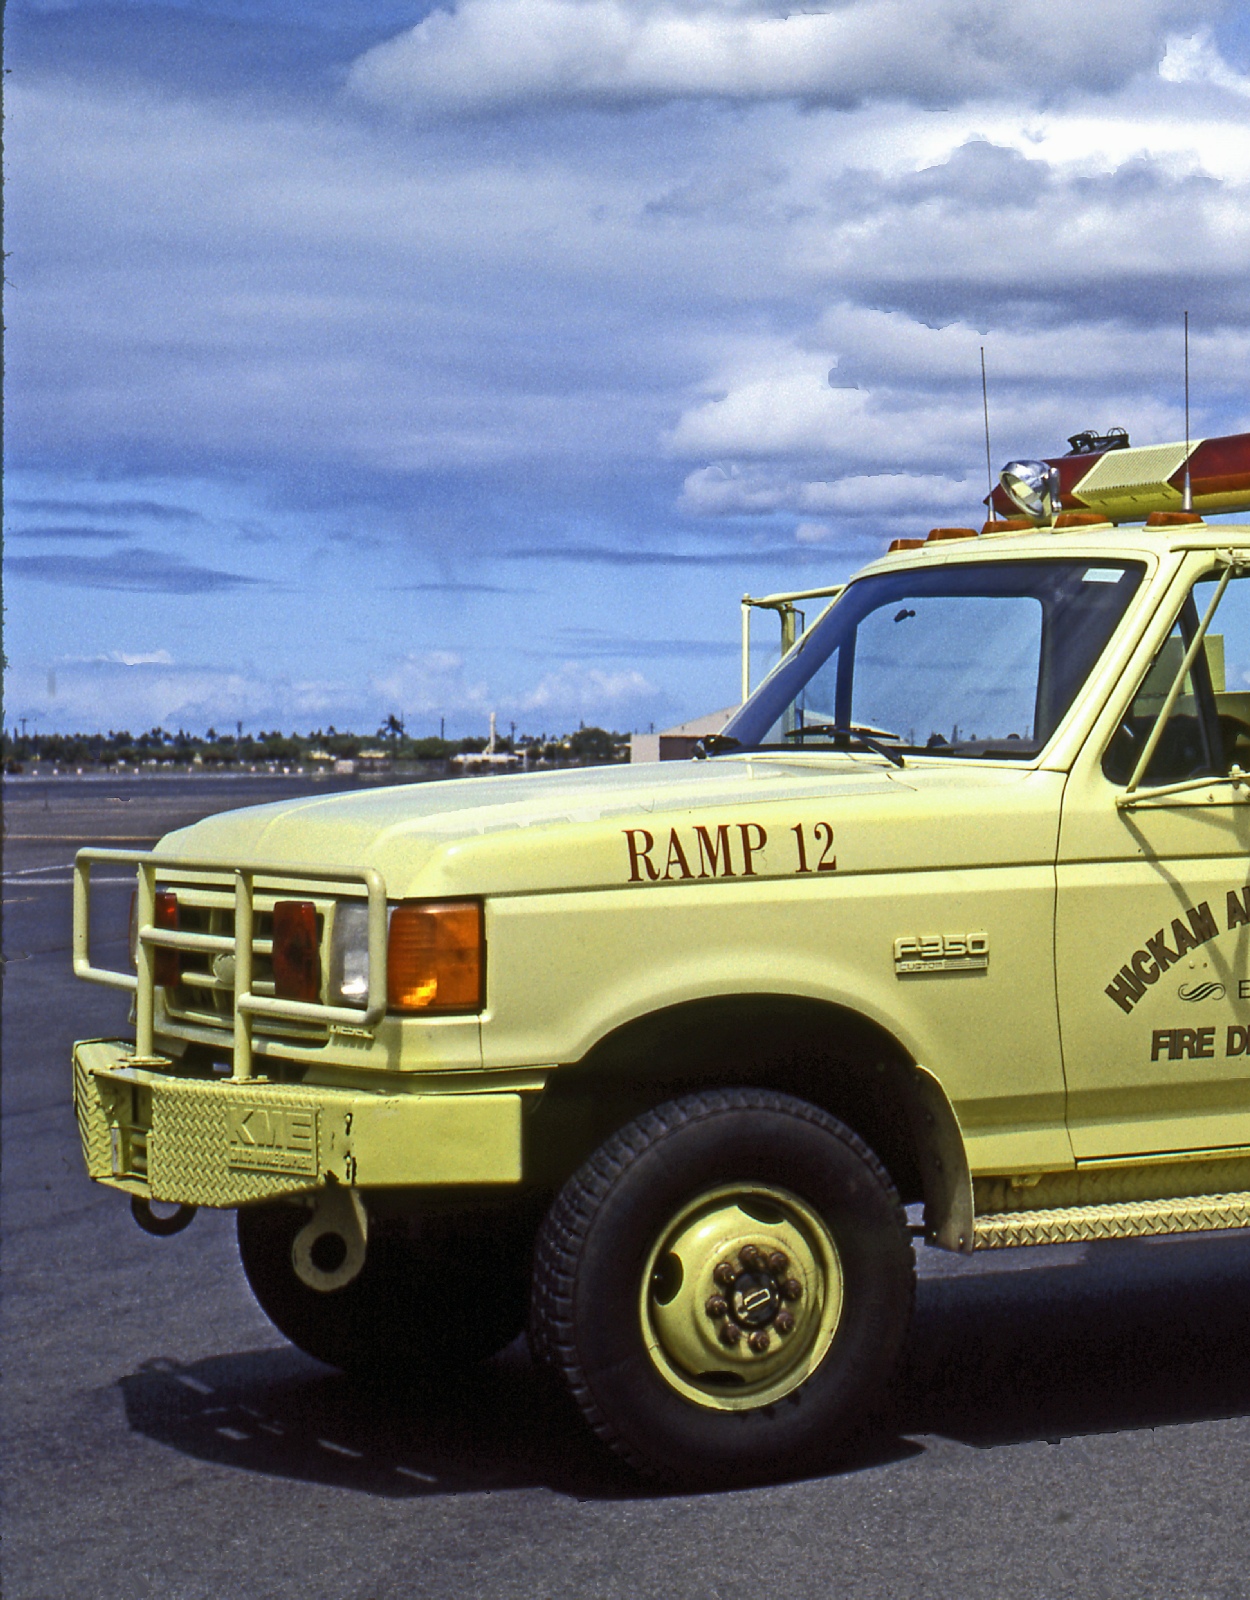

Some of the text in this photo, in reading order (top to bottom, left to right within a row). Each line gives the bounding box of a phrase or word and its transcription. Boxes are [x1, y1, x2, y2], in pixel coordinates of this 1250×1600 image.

[621, 821, 837, 882] RAMP 12
[1104, 901, 1219, 1014] HICKAM
[1151, 1026, 1216, 1062] FIRE
[229, 1106, 312, 1152] KME
